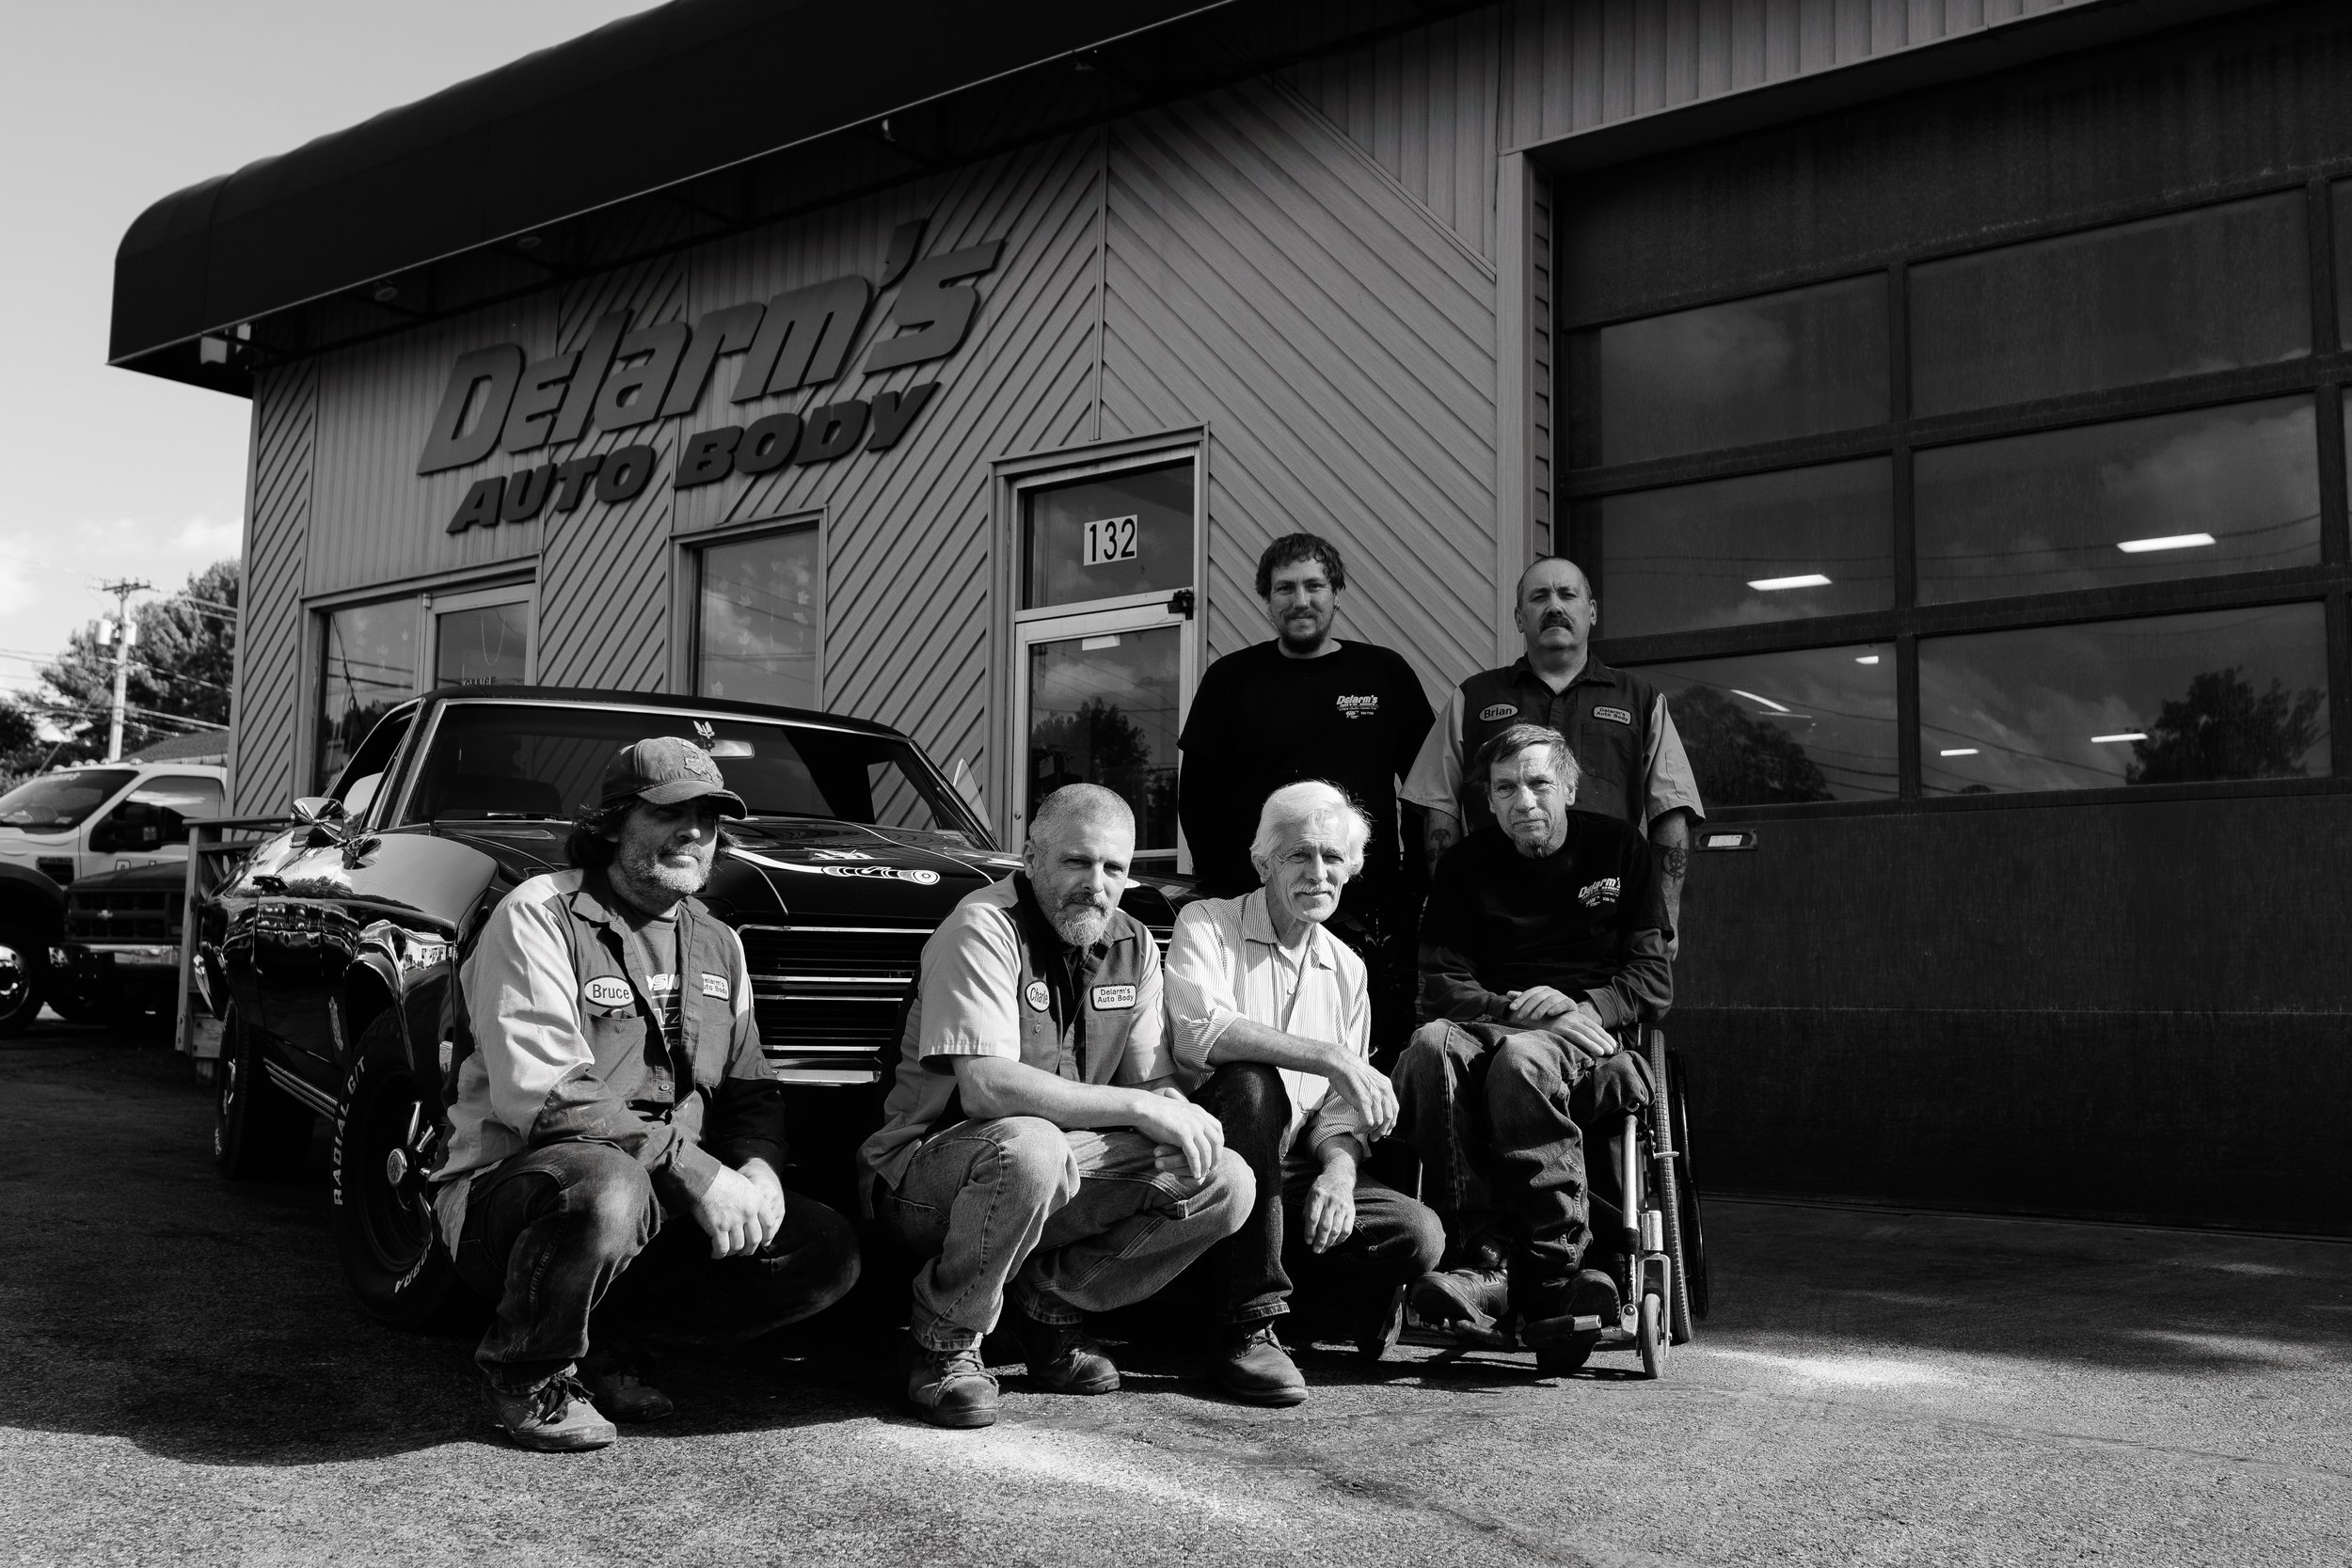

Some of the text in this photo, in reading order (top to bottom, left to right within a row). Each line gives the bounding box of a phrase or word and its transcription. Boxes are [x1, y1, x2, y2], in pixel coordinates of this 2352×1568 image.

[446, 381, 942, 534] AUTO BODY
[1089, 517, 1136, 562] 132
[1336, 694, 1378, 705] Delarm's
[1484, 705, 1513, 719] Brian
[1599, 707, 1626, 716] Delarm's
[1613, 713, 1628, 721] Body
[704, 976, 725, 989] elarm's
[593, 984, 630, 1000] Bruce
[1100, 987, 1131, 996] Delarm's
[1097, 993, 1135, 1004] Auto Body
[333, 1055, 365, 1205] RADIAL G/T
